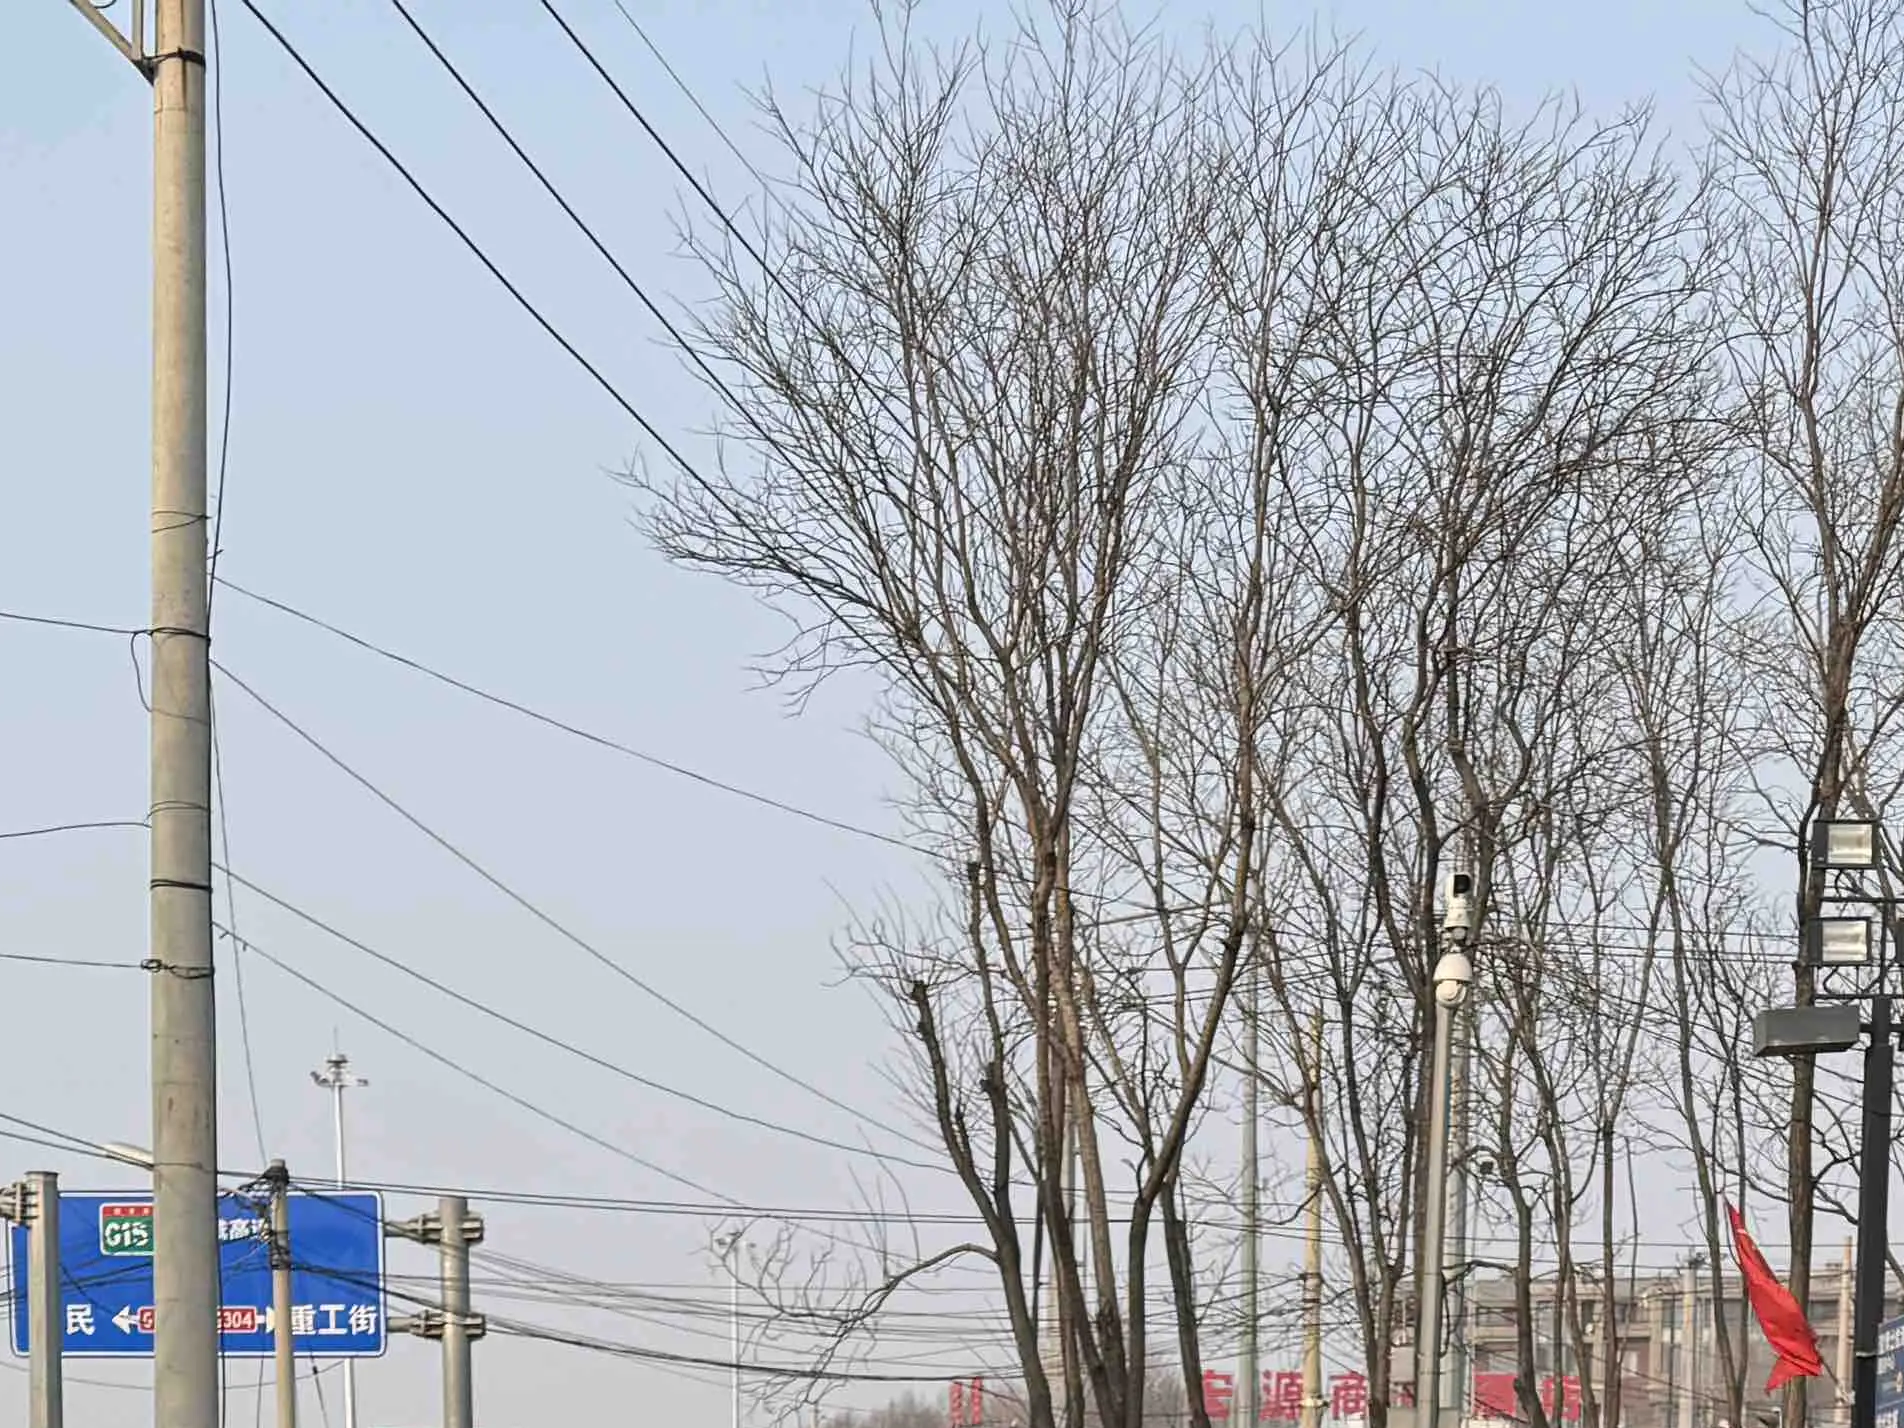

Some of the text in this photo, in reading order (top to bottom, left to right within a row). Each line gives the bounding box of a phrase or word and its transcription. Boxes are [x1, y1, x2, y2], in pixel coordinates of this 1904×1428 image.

[104, 1220, 150, 1247] G15
[217, 1311, 253, 1329] 304
[291, 1304, 377, 1336] 重工街
